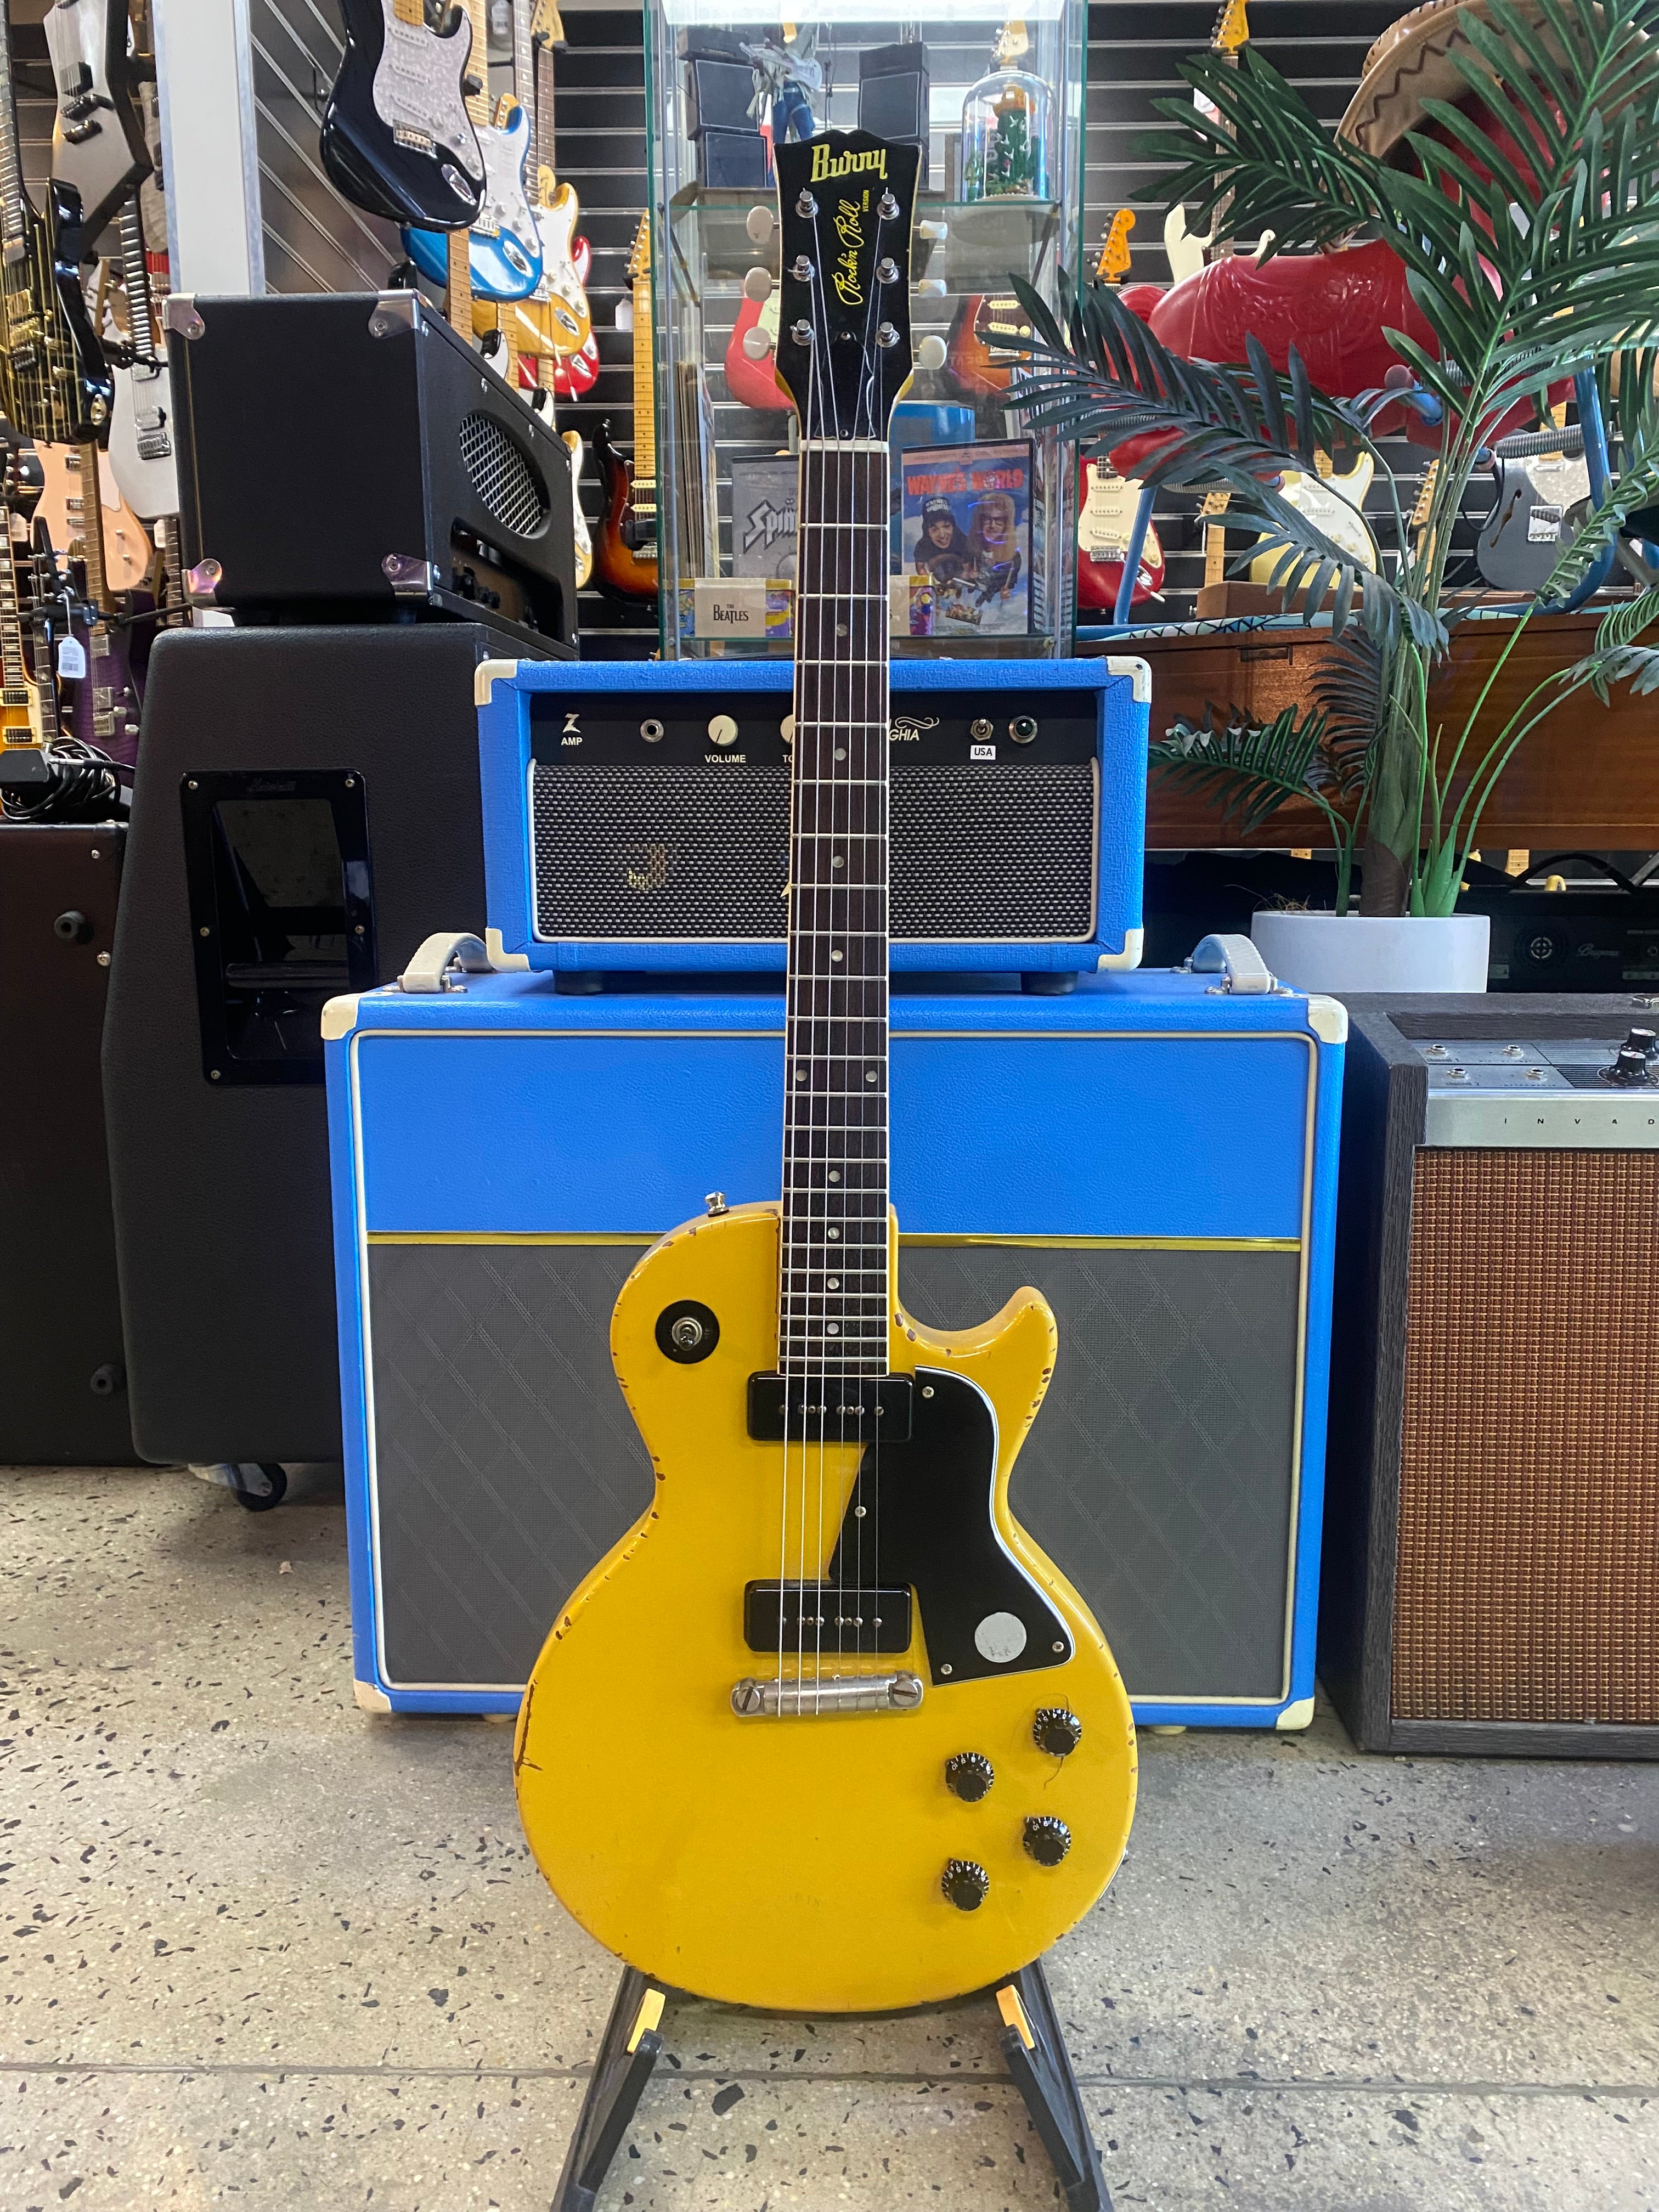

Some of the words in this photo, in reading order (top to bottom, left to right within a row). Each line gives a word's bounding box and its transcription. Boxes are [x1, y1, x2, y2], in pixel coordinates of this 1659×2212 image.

[810, 144, 888, 182] Burny
[833, 199, 865, 247] Roll
[907, 467, 967, 495] WAYNE'S
[889, 729, 919, 741] GHIA
[561, 737, 583, 746] AMP
[974, 747, 992, 756] USA
[704, 754, 746, 763] VOLUME
